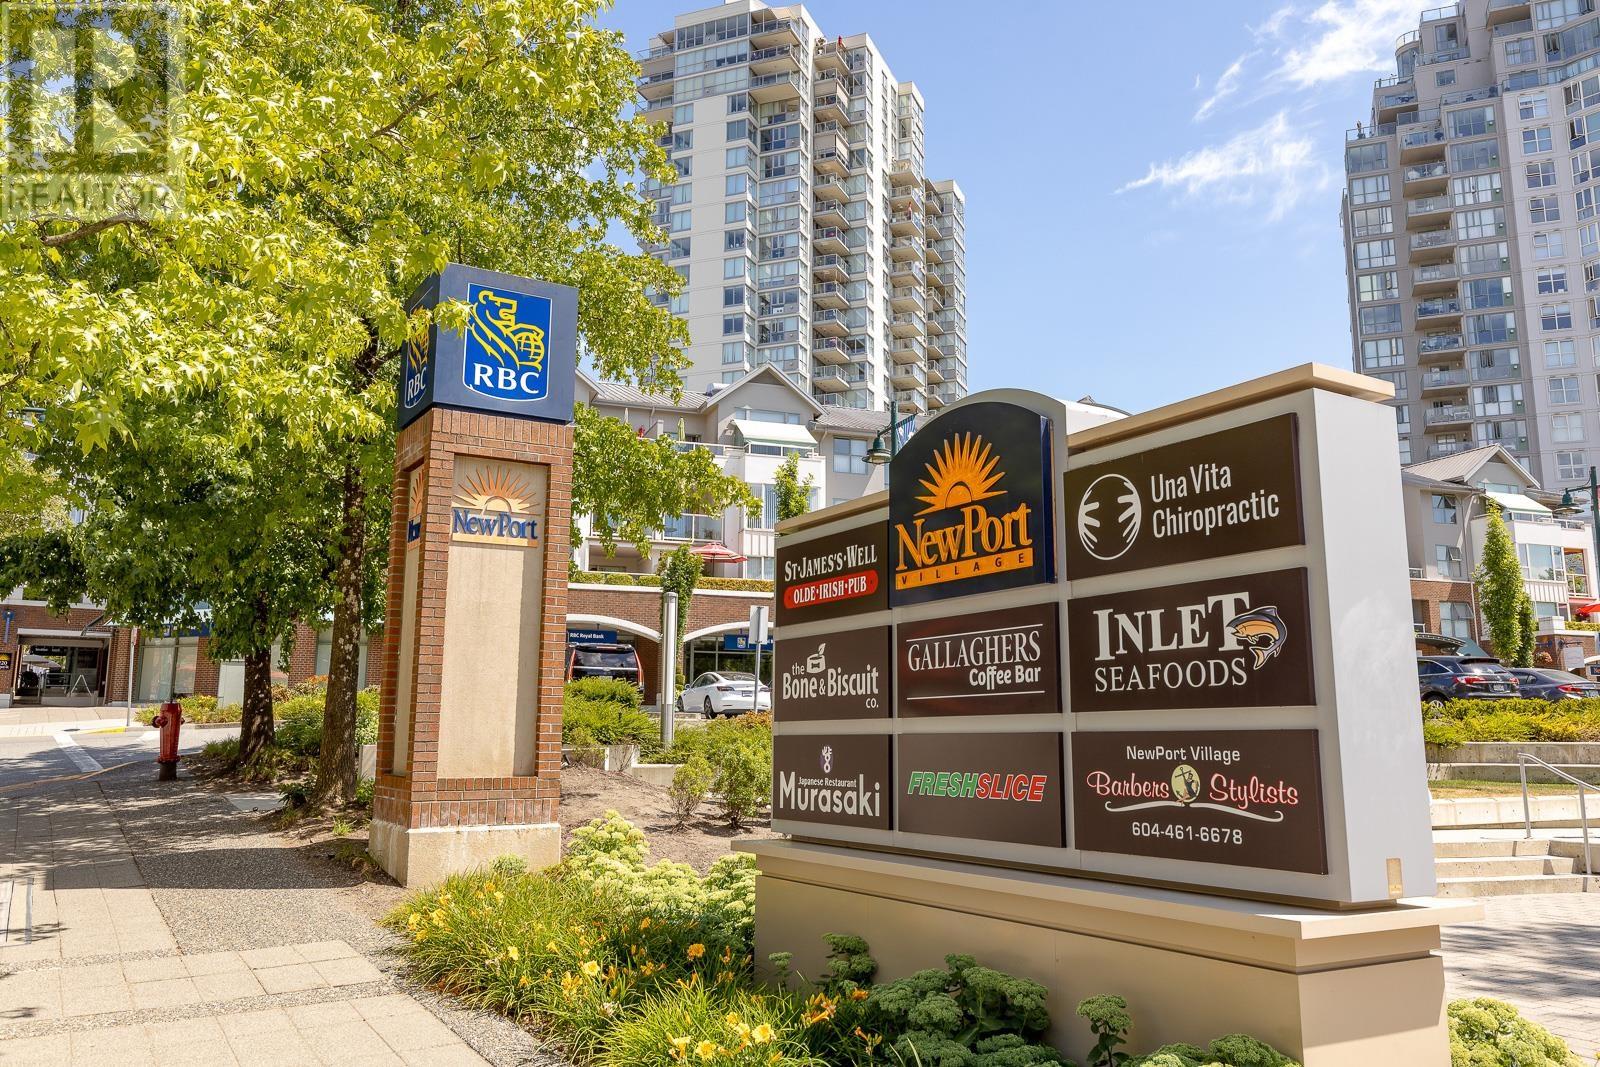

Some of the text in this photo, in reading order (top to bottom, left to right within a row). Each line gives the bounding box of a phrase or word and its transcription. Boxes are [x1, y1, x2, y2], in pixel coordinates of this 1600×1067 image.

[407, 366, 427, 400] RBC
[473, 362, 540, 394] RBC
[1151, 463, 1232, 503] Una Vita
[453, 508, 538, 540] NewPort
[1152, 489, 1280, 539] Chiropractic
[895, 502, 1033, 571] NewPort
[848, 575, 867, 594] PUB
[901, 552, 1025, 585] VILLAGE
[1092, 591, 1250, 661] INLET
[907, 630, 1041, 672] GALLAGHERS
[782, 664, 879, 700] Bone & Biscuit
[791, 662, 805, 676] the
[969, 664, 1042, 691] Coffee Bar
[1094, 657, 1248, 693] SEAFOODS
[1126, 745, 1241, 765] NewPort Village
[779, 770, 881, 817] Murasaki
[798, 776, 857, 788] Japanese Restaurant
[907, 770, 1048, 802] FRESHSLICE
[1086, 770, 1299, 810] Barbers Stylists
[1131, 821, 1243, 845] 604-461-6678
